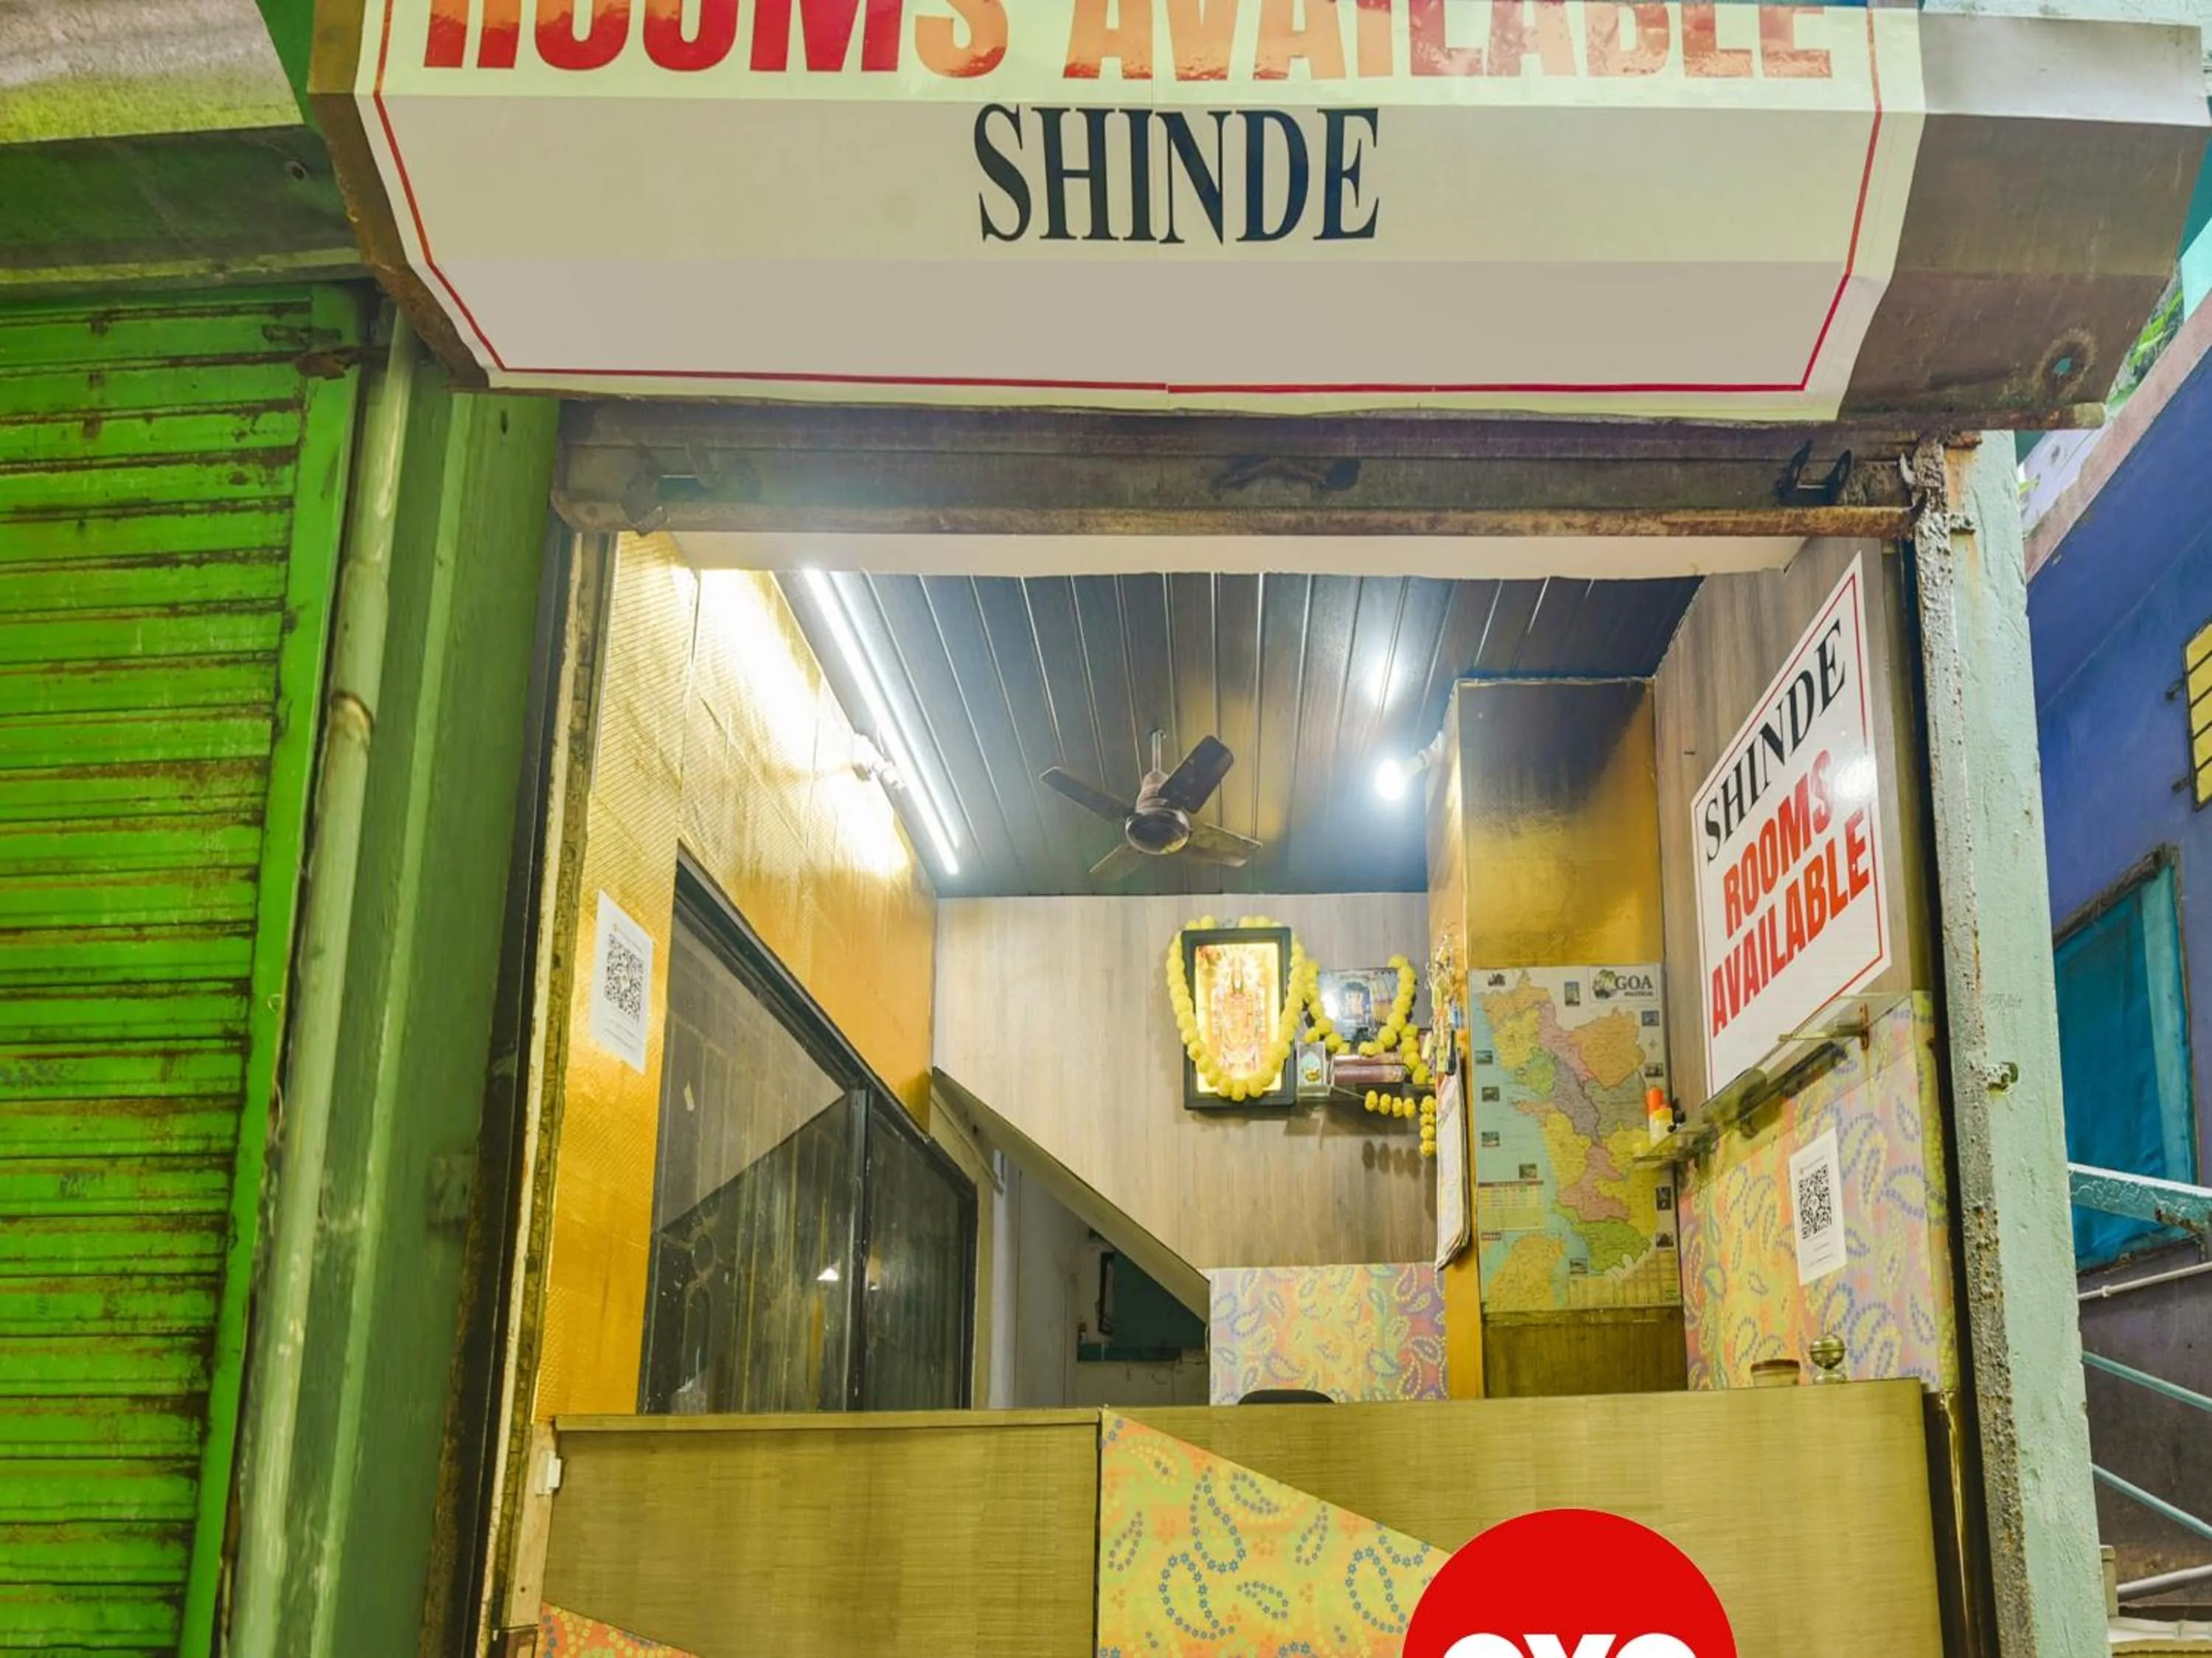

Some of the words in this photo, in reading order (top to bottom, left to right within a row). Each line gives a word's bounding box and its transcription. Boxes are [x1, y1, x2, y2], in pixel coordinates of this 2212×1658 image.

[973, 103, 1380, 245] SHINDE
[1704, 618, 1846, 866] SHINDE
[1710, 805, 1871, 1039] AVAILABLE
[1722, 749, 1834, 940] ROOMS
[1614, 974, 1653, 991] GOA
